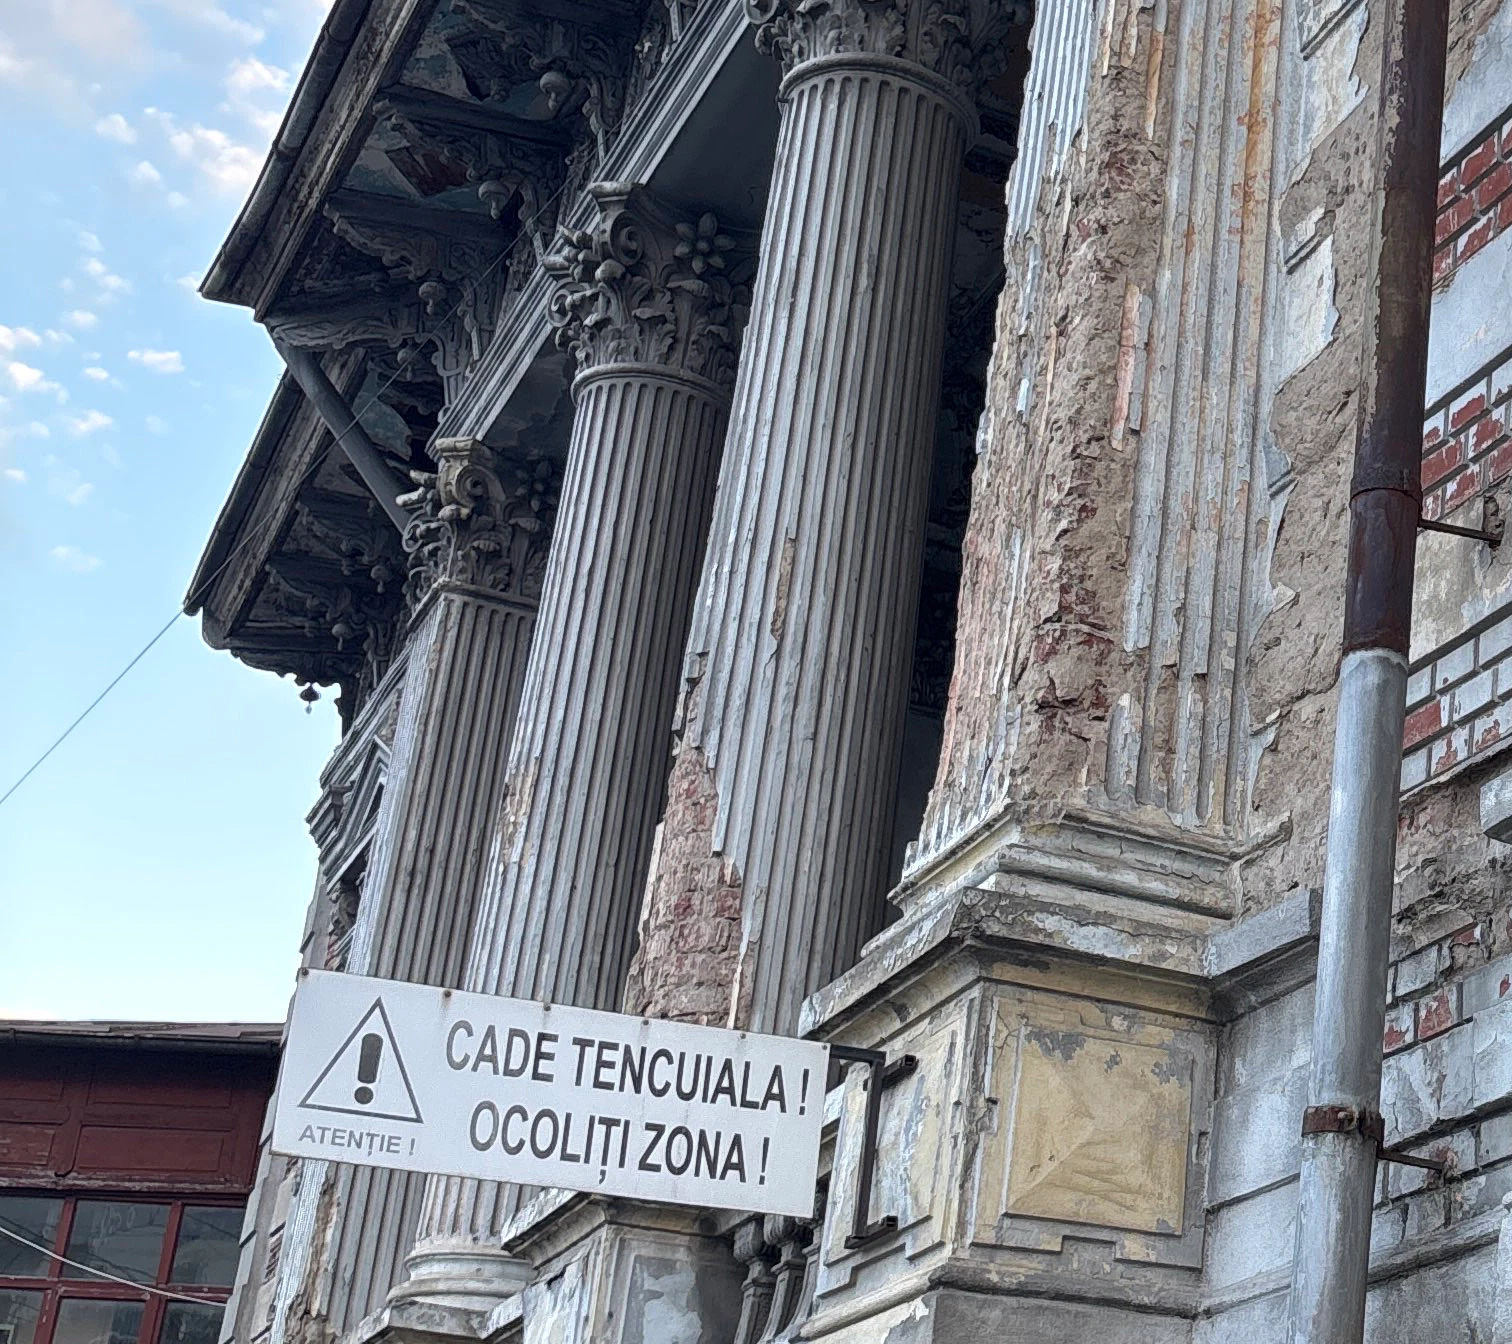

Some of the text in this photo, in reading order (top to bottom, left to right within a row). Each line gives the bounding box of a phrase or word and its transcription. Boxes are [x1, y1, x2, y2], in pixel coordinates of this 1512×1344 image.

[446, 1019, 558, 1082] CADE
[572, 1036, 788, 1113] TENCUIALA
[638, 1122, 748, 1183] ZONA
